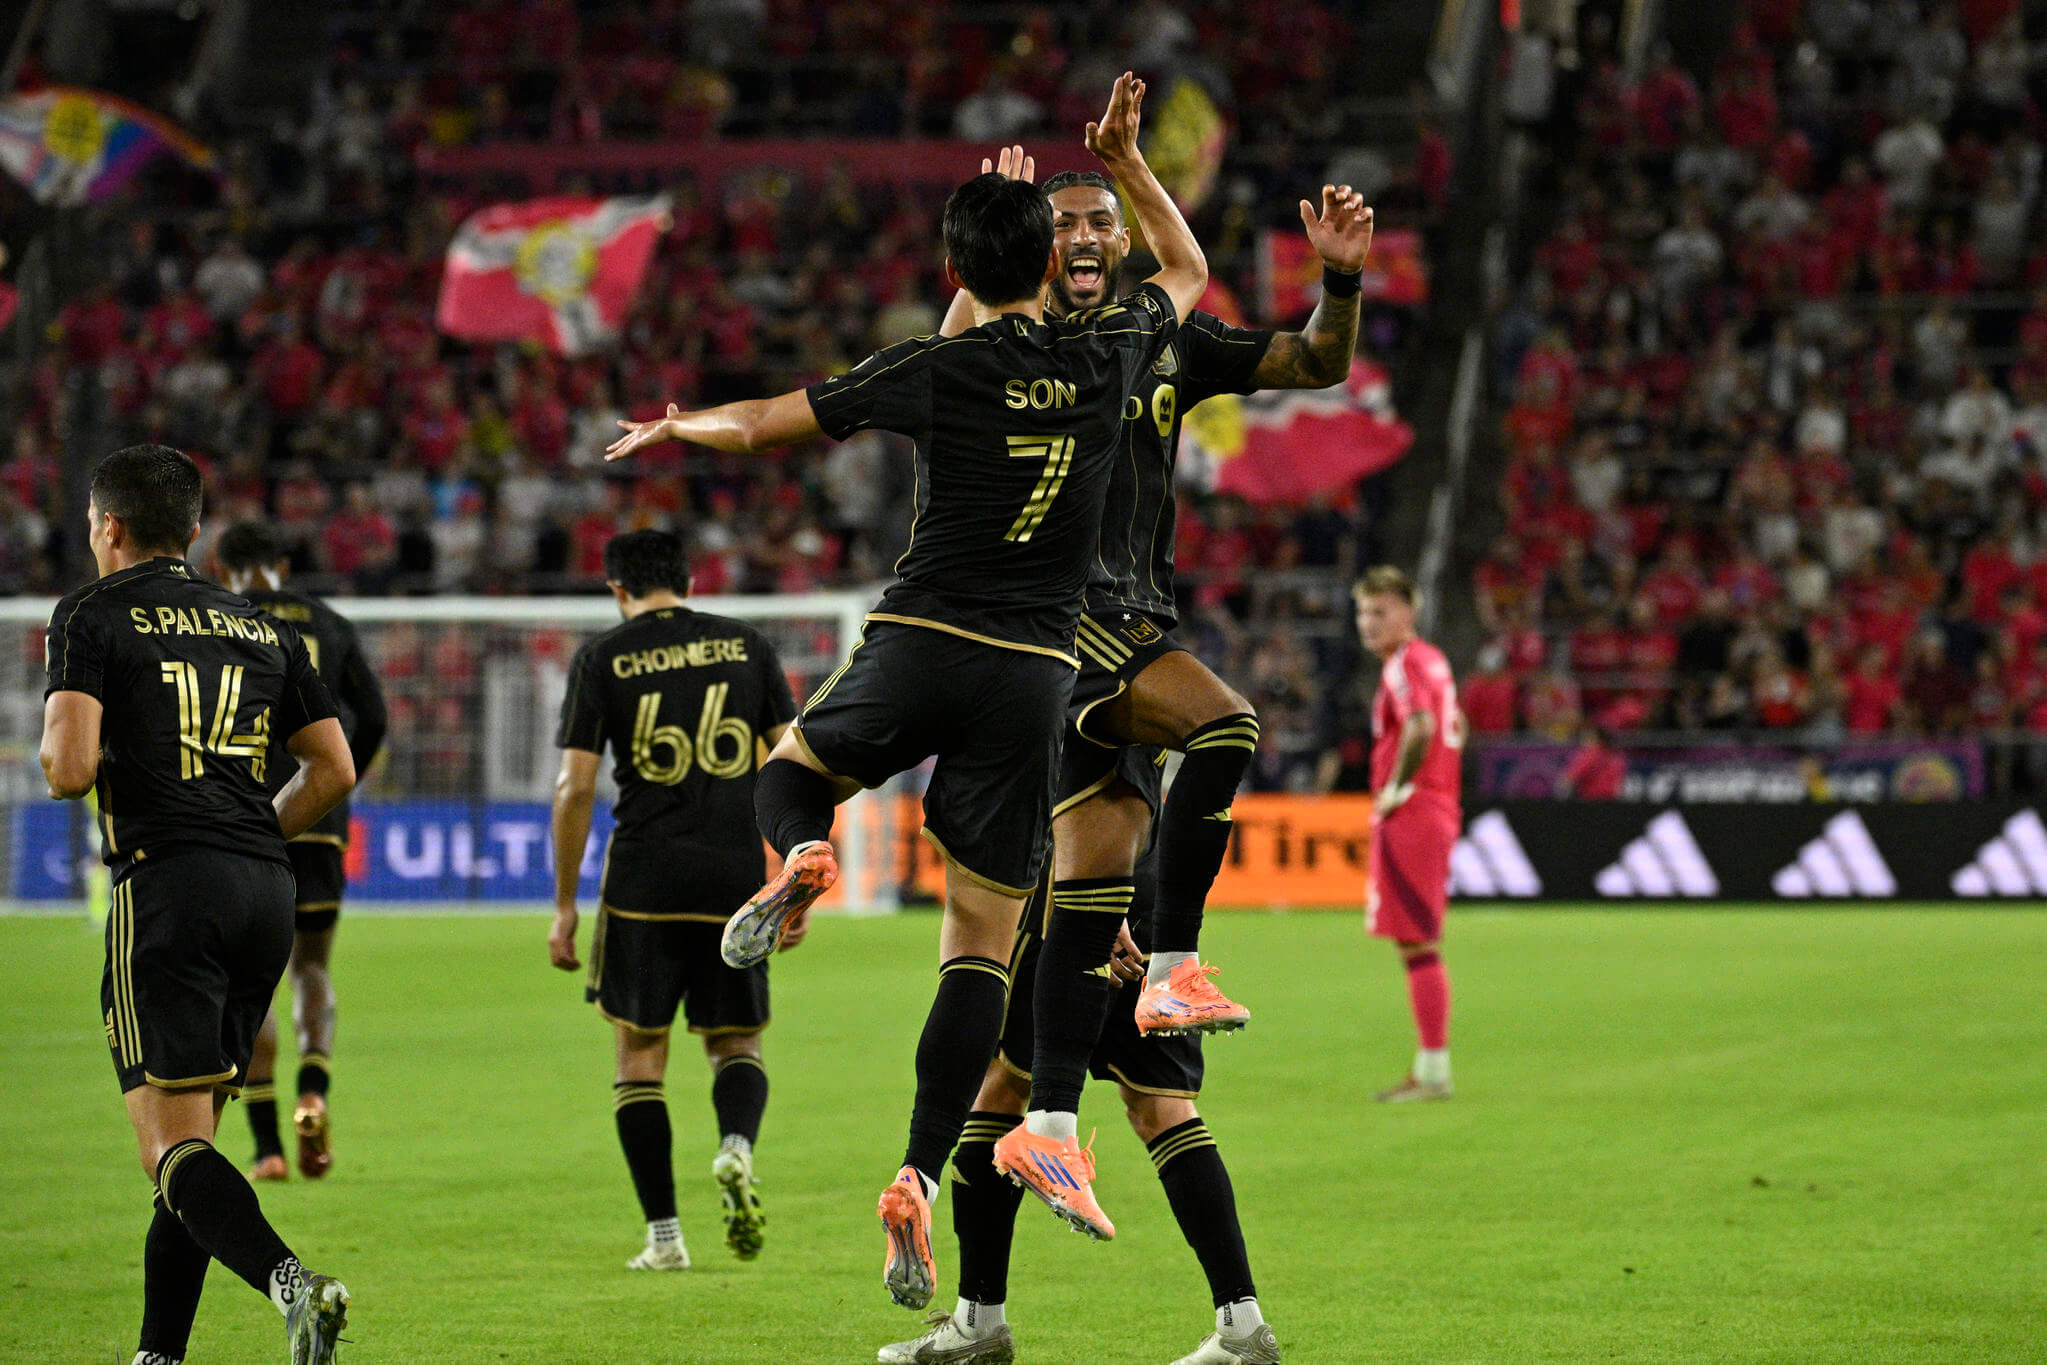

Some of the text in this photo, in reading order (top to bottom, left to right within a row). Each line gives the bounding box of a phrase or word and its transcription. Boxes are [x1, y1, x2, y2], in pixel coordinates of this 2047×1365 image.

[1006, 379, 1076, 410] SON
[1003, 433, 1075, 542] 7
[130, 606, 279, 647] S.PALENCIA
[160, 661, 270, 783] 14
[631, 681, 752, 786] 66
